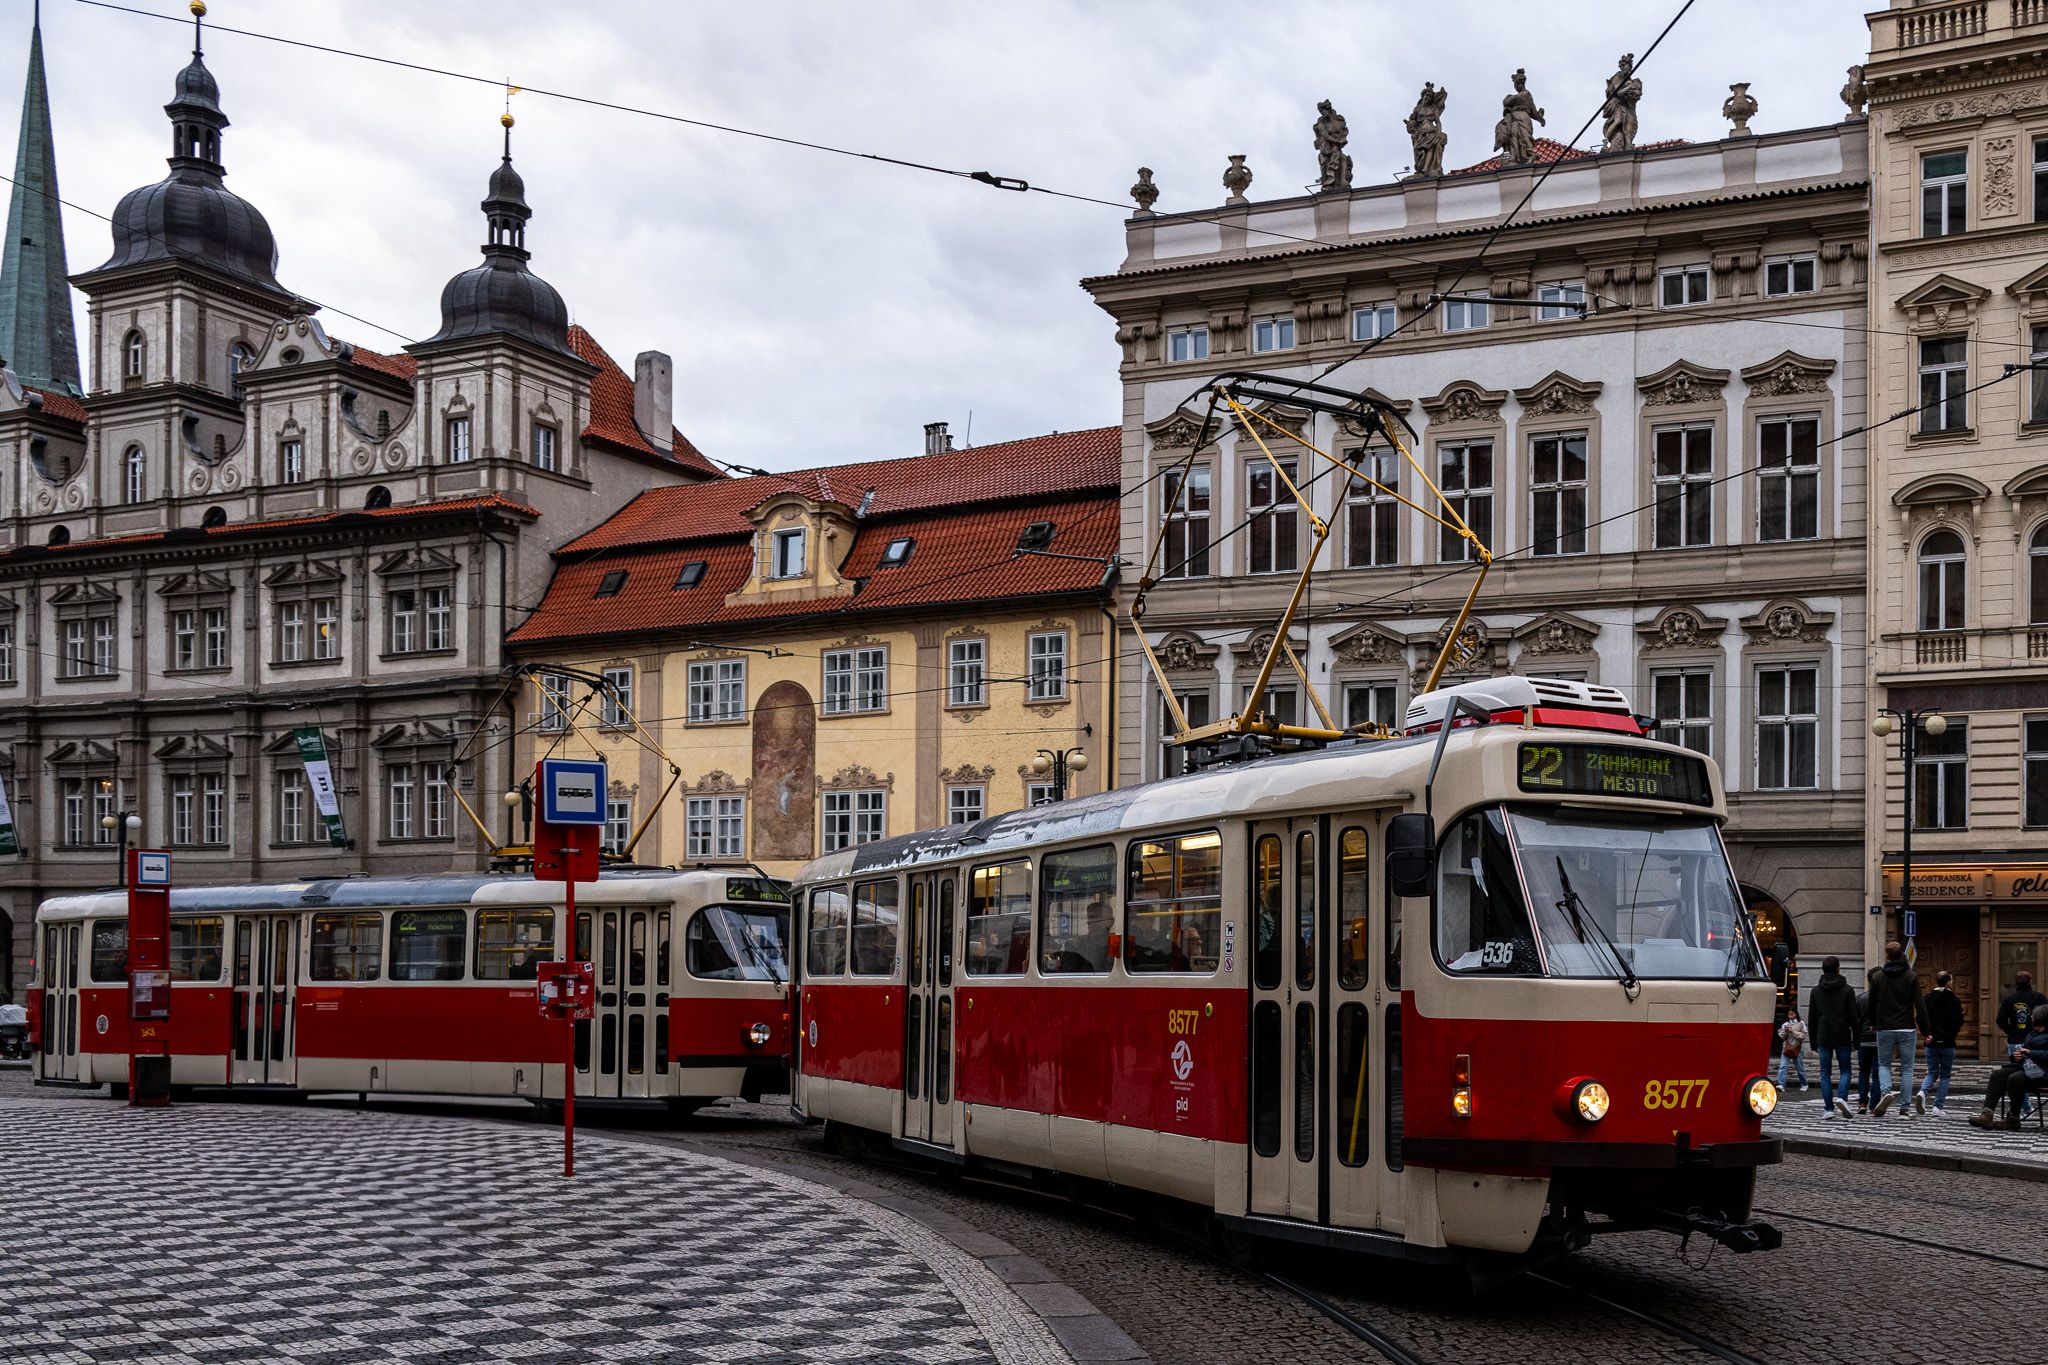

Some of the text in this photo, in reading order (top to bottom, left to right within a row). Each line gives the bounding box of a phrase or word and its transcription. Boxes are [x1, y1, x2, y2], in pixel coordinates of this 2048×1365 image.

[1522, 747, 1563, 786] 22
[1910, 874, 1972, 883] ALOSTRANSKÁ
[1483, 941, 1514, 964] 536
[1168, 1009, 1199, 1035] 8577
[1176, 1096, 1188, 1114] pid
[1643, 1079, 1710, 1110] 8577
